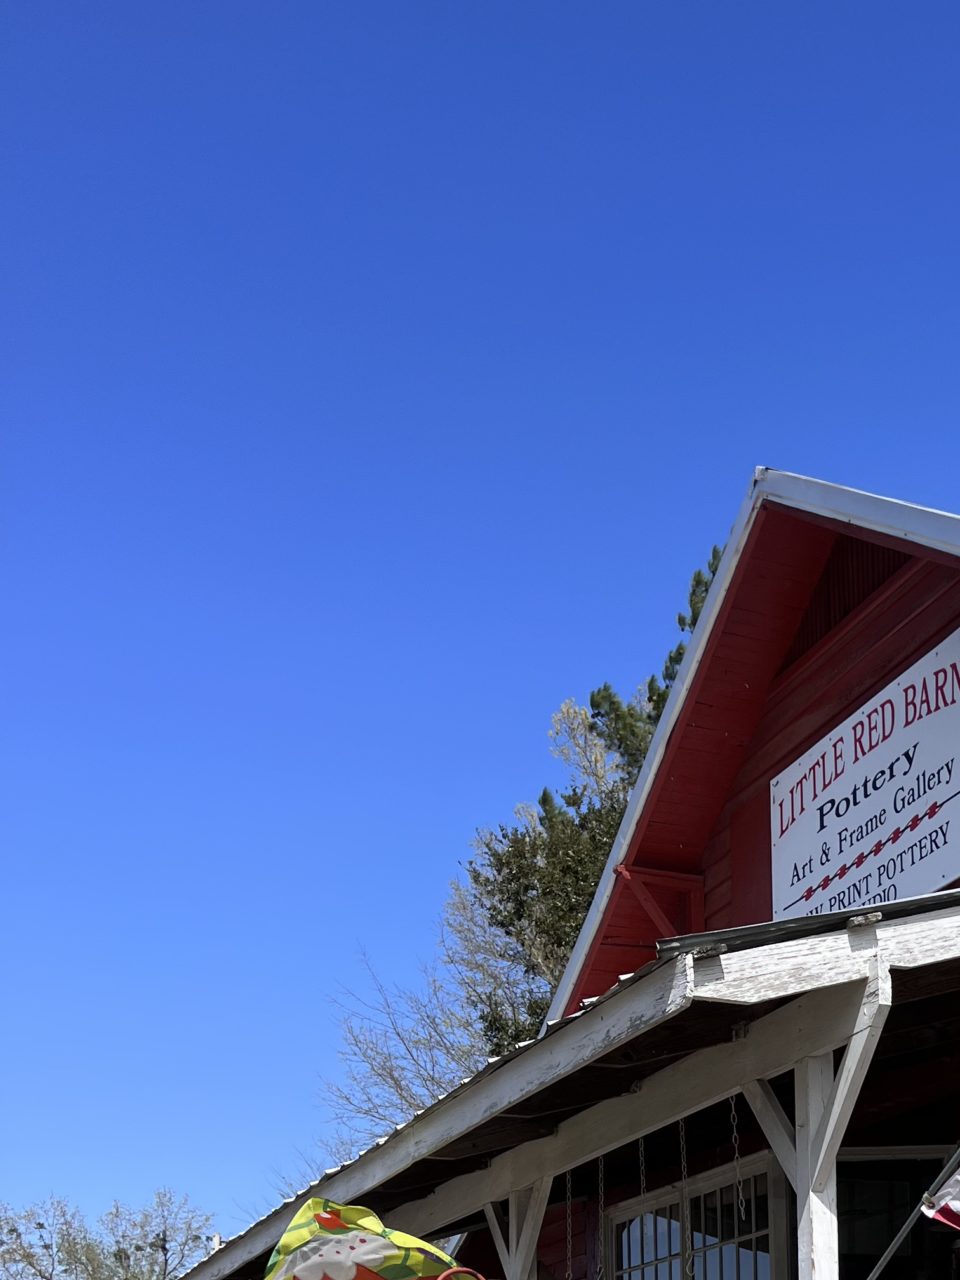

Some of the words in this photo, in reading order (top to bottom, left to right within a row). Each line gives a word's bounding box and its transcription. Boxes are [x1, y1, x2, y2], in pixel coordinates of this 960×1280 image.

[778, 736, 846, 839] LITTLE
[851, 699, 895, 765] RED
[789, 857, 814, 887] Art
[819, 843, 831, 867] &
[837, 808, 887, 854] Frame
[893, 757, 955, 814] Gallery
[816, 742, 919, 834] Pottery
[828, 873, 872, 912] PRINT
[876, 820, 951, 888] POTTERY
